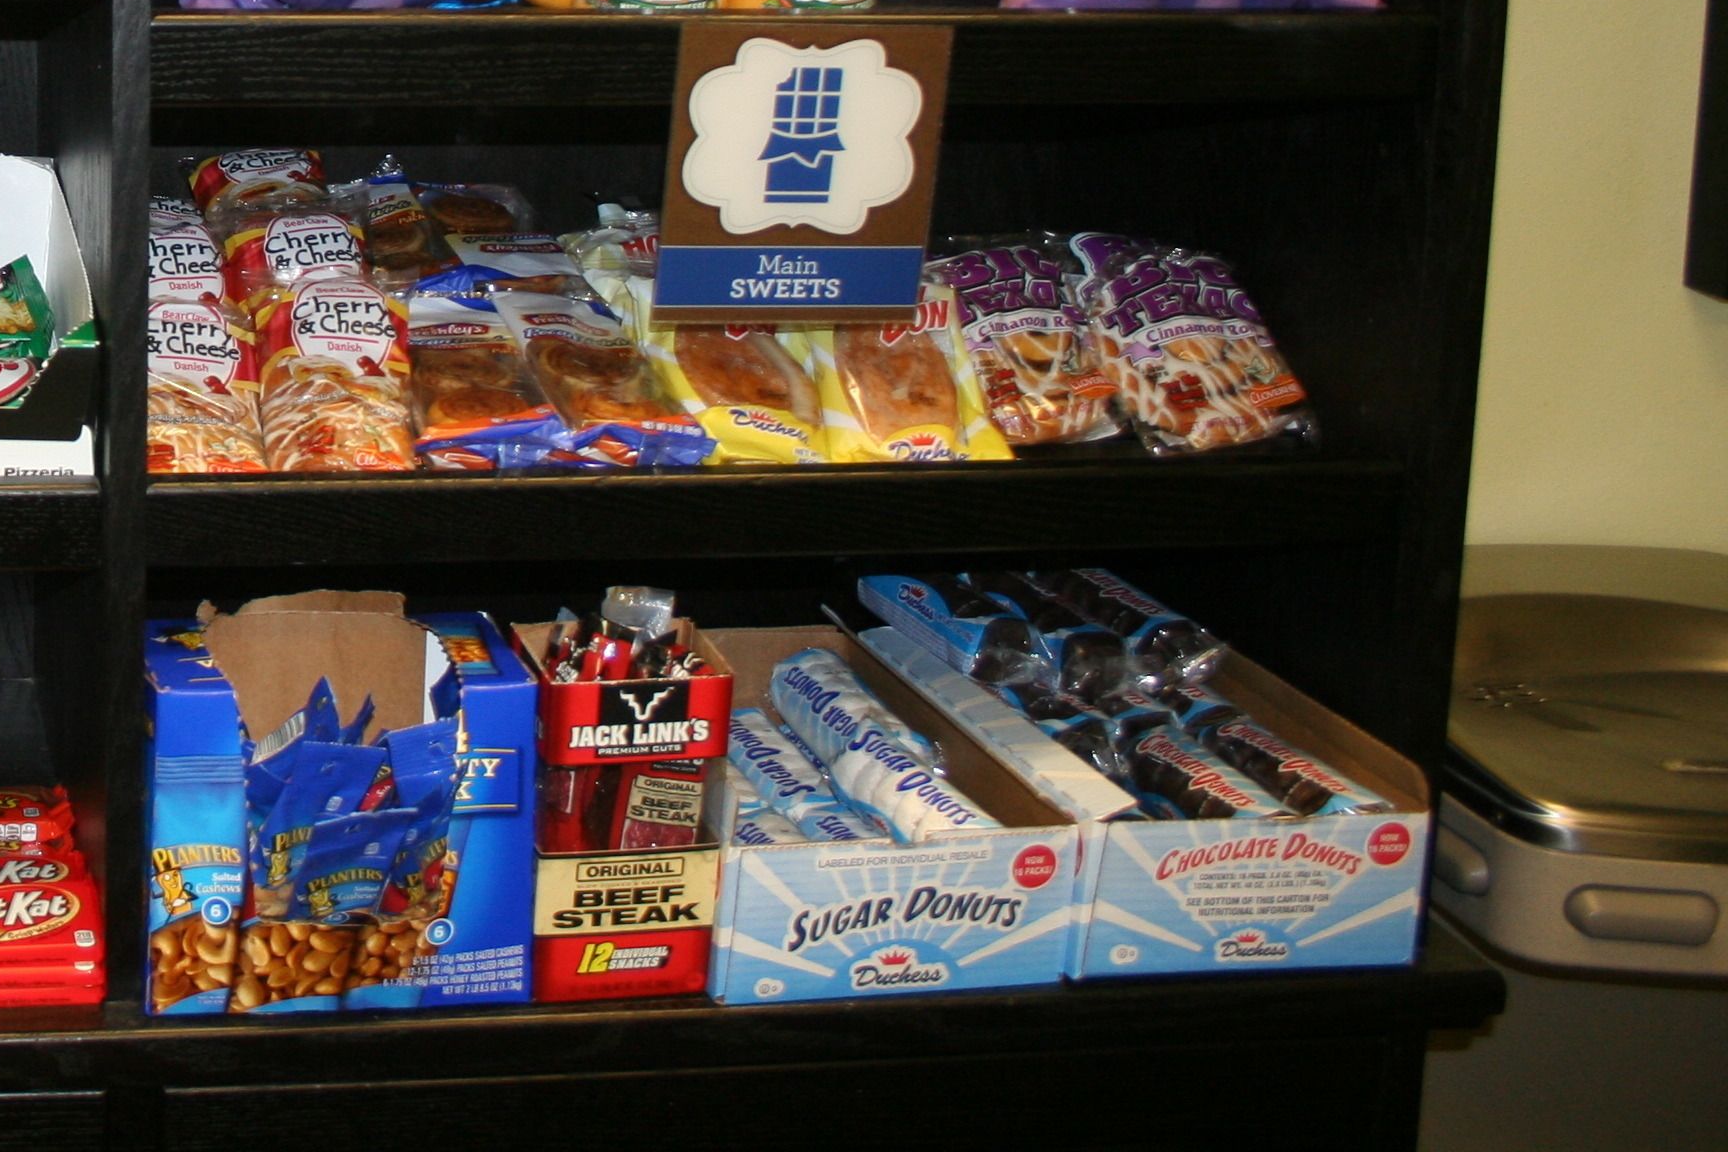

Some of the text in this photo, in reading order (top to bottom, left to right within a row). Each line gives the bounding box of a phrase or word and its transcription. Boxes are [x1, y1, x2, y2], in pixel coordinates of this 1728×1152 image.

[264, 232, 357, 254] Cherry
[298, 248, 362, 267] Cheese
[756, 255, 819, 275] Main
[730, 278, 841, 298] SWEETS
[162, 310, 210, 324] BearClaw
[293, 297, 388, 323] Cherry
[297, 315, 397, 339] & Cheese
[978, 316, 1048, 338] Cinnamon
[1146, 323, 1222, 342] Cinnamon
[166, 335, 241, 360] Cheese
[327, 342, 363, 354] Danish
[174, 361, 209, 373] Danish
[730, 408, 809, 444] Duchess
[569, 718, 709, 747] JACK LINK'S
[598, 744, 681, 755] PREMIUM CUTS
[644, 779, 696, 792] ORIGINAL
[849, 729, 977, 827] SUGAR DONUTS
[1190, 771, 1257, 808] DONUTS
[640, 796, 692, 810] BEEF
[631, 806, 697, 822] STEAK
[154, 847, 241, 871] PLANTERS
[818, 850, 988, 868] LABELED FOR INDIVIDUAL RESALE
[1156, 837, 1279, 881] CHOCOLATE
[1281, 833, 1362, 875] DONUTS
[211, 872, 241, 883] Salted
[587, 862, 674, 878] ORIGINAL
[195, 883, 241, 895] Cashews
[307, 869, 383, 891] PLANTERS
[573, 884, 685, 908] BEEF
[1186, 894, 1329, 906] SEE BOTTOM OF FOR
[210, 904, 221, 918] 6
[552, 902, 700, 929] STEAK
[788, 886, 1022, 952] SUGAR DONUTS
[1256, 906, 1314, 914] INFORMATION
[434, 927, 444, 937] 6
[456, 949, 495, 961] PACKS SALTED
[577, 942, 669, 974] 12 INDIVIDUAL
[1221, 942, 1287, 958] Duchess
[476, 960, 496, 970] SALTED
[608, 957, 659, 970] SNACKS
[854, 963, 944, 987] Duchess
